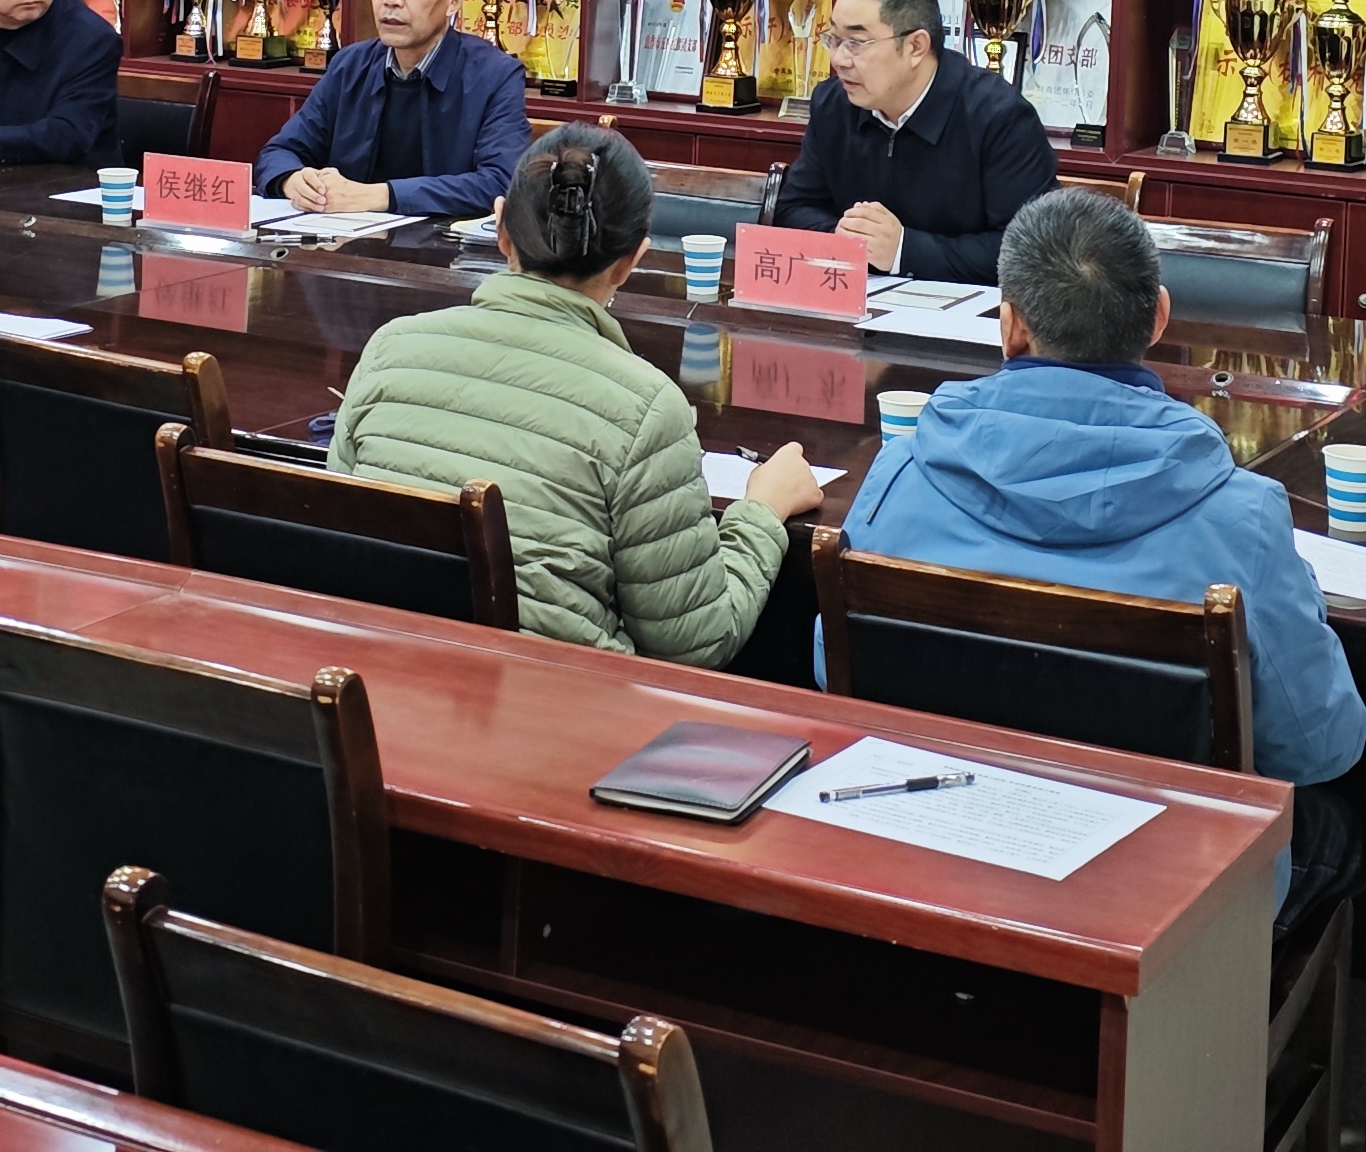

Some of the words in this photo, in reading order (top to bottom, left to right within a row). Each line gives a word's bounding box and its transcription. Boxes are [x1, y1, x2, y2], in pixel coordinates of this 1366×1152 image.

[156, 168, 236, 206] 侯继红
[753, 248, 850, 292] 高广东
